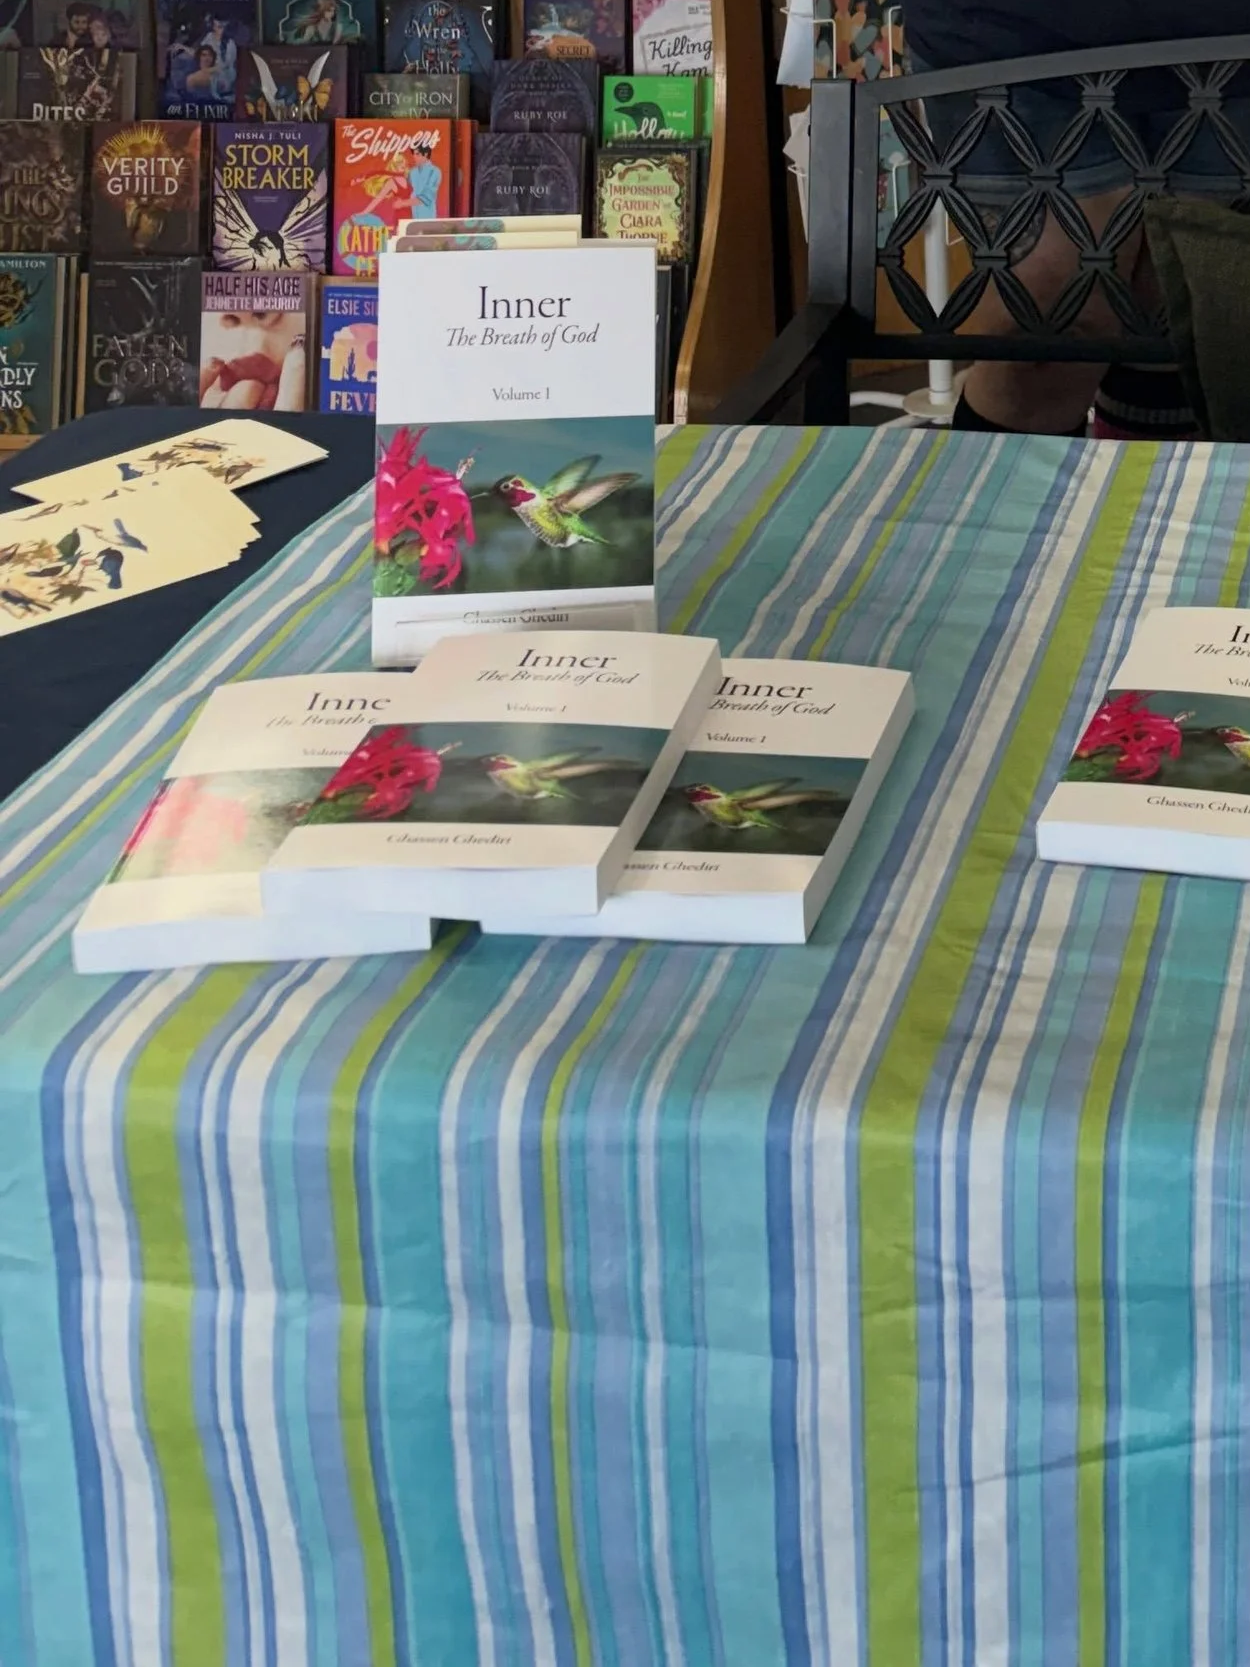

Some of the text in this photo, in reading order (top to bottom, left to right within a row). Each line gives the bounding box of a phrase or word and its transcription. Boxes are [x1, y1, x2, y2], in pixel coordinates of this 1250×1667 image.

[428, 3, 446, 17] the
[412, 20, 461, 40] Wren
[556, 46, 592, 56] SECRET
[649, 35, 712, 60] Killing
[369, 92, 452, 105] CITY IRON
[514, 111, 568, 122] RUBY ROE
[235, 132, 264, 140] NISHA
[343, 125, 356, 139] The
[345, 127, 440, 164] Shippers
[225, 143, 309, 166] STORM
[102, 157, 185, 176] VERITY
[107, 177, 179, 196] GUILD
[223, 167, 315, 190] BREAKER
[496, 186, 526, 195] RUBY
[612, 198, 661, 212] GARDEN
[620, 213, 662, 229] CLARA
[205, 277, 300, 297] HALF HIS AGE
[205, 296, 301, 311] JENNETTE MCCURDY
[328, 299, 360, 315] ELSIE
[478, 286, 571, 321] Inner
[447, 323, 600, 351] The Breath of God
[493, 387, 540, 402] Volume
[1194, 642, 1225, 656] The
[517, 648, 617, 669] Inner
[476, 669, 640, 686] The Breath of God
[715, 676, 814, 700] Inner
[709, 698, 836, 717] Breath of God
[707, 732, 757, 744] Volume
[1147, 795, 1204, 811] Ghassen
